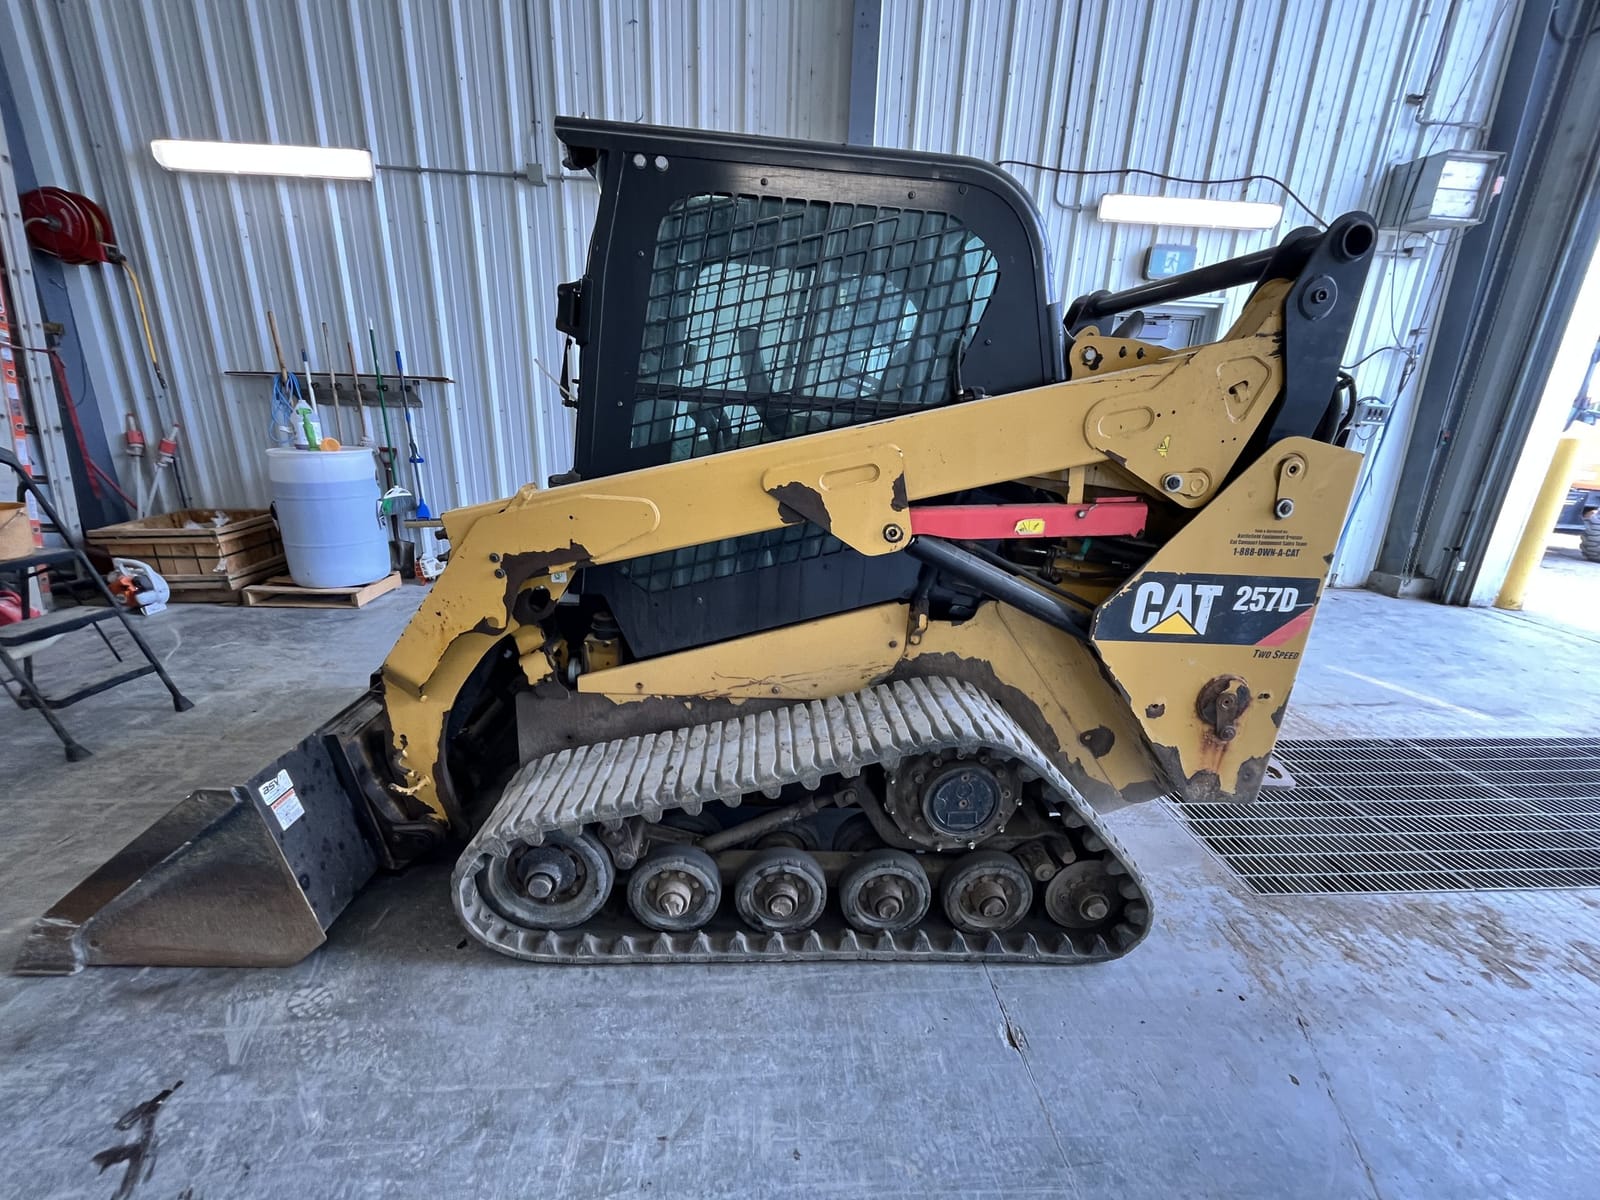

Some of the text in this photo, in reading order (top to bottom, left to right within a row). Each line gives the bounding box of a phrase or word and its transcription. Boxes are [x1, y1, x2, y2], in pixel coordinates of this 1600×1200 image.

[1233, 547, 1300, 557] 1-888-OWN-A-CAT
[1130, 581, 1299, 635] CAT 257D
